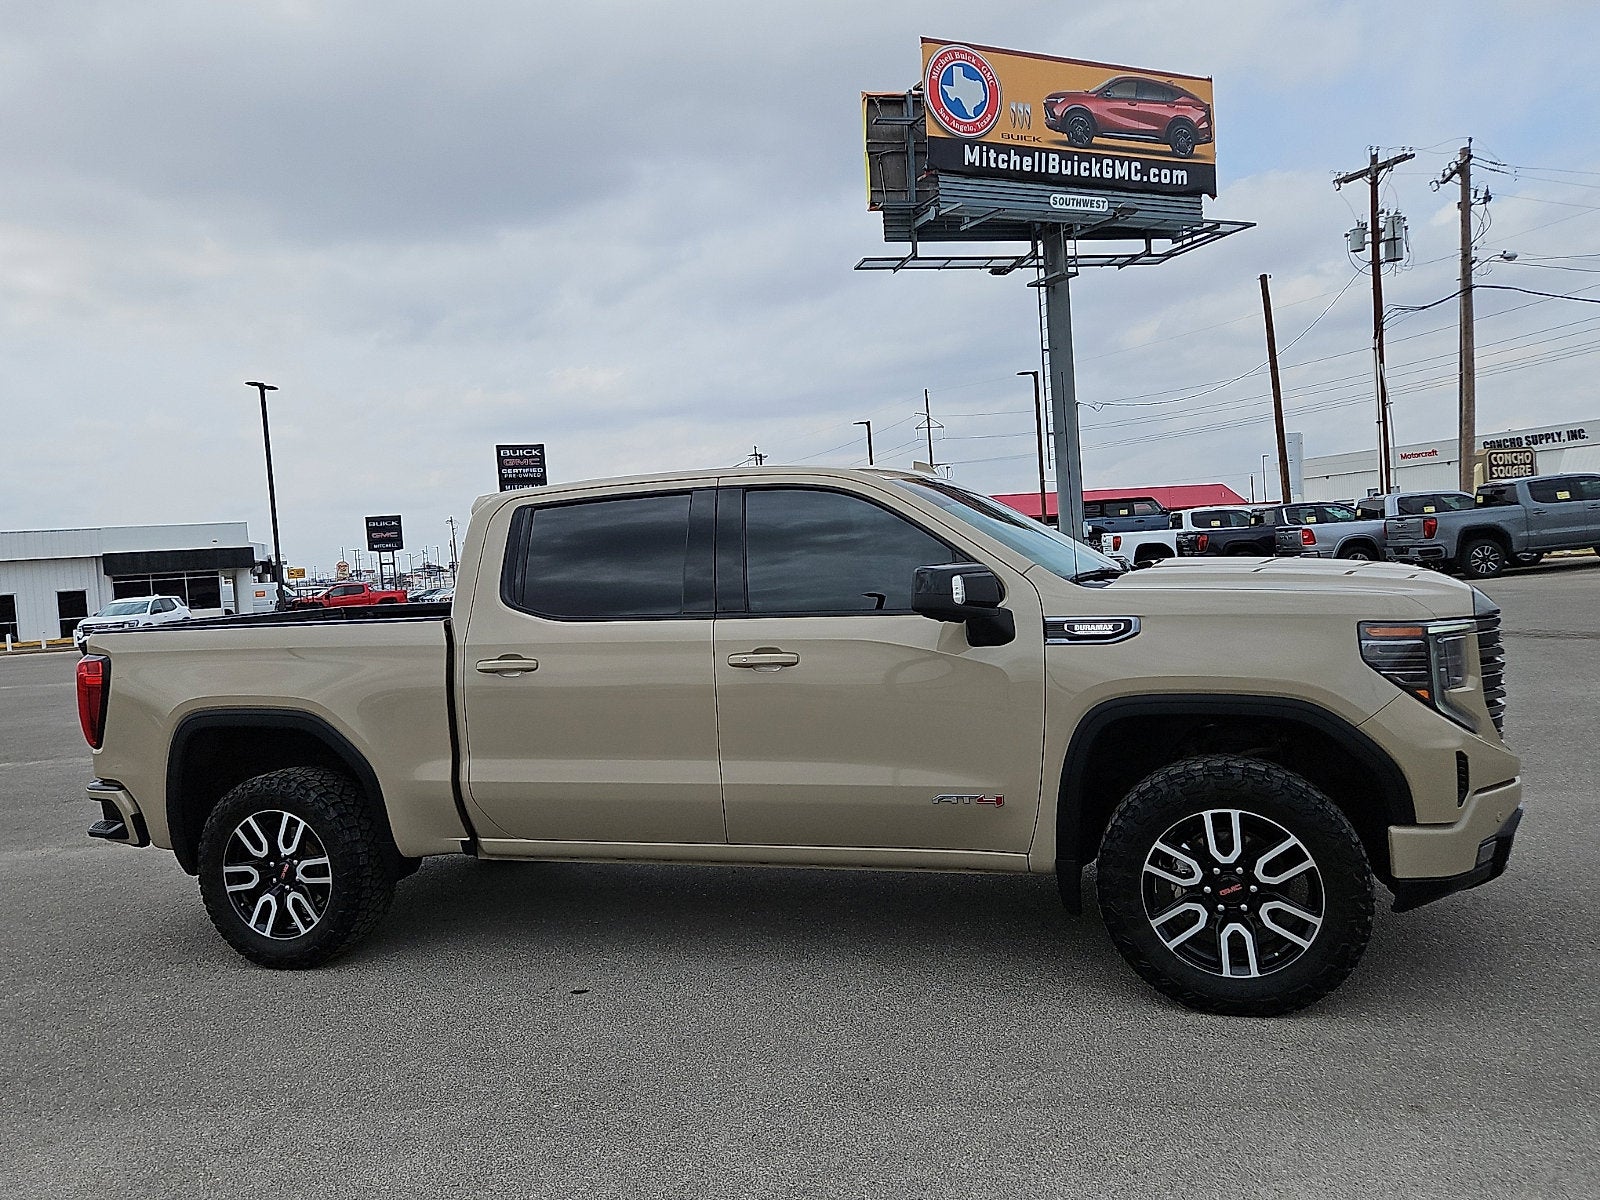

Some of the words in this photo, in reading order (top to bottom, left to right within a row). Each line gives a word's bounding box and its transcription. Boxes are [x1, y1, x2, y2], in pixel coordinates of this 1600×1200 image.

[931, 52, 954, 81] Mitchell
[954, 51, 977, 64] Buick
[981, 65, 996, 87] GMC
[938, 107, 950, 122] San
[950, 122, 977, 133] Angelo,
[976, 113, 992, 130] Texas
[1001, 133, 1042, 143] BUICK
[963, 144, 1188, 186] MitchellBuickGMC.com
[1052, 196, 1107, 210] SOUTHWEST
[1483, 437, 1523, 449] CONCHO
[1524, 430, 1566, 446] SUPPLY,
[500, 449, 541, 457] BUICK
[1400, 449, 1439, 461] Motorcraft
[1490, 452, 1532, 465] CONCHO
[503, 458, 540, 466] GMC
[1492, 464, 1533, 478] SQUARE
[932, 794, 1004, 808] AT4
[1219, 883, 1243, 896] GMC
